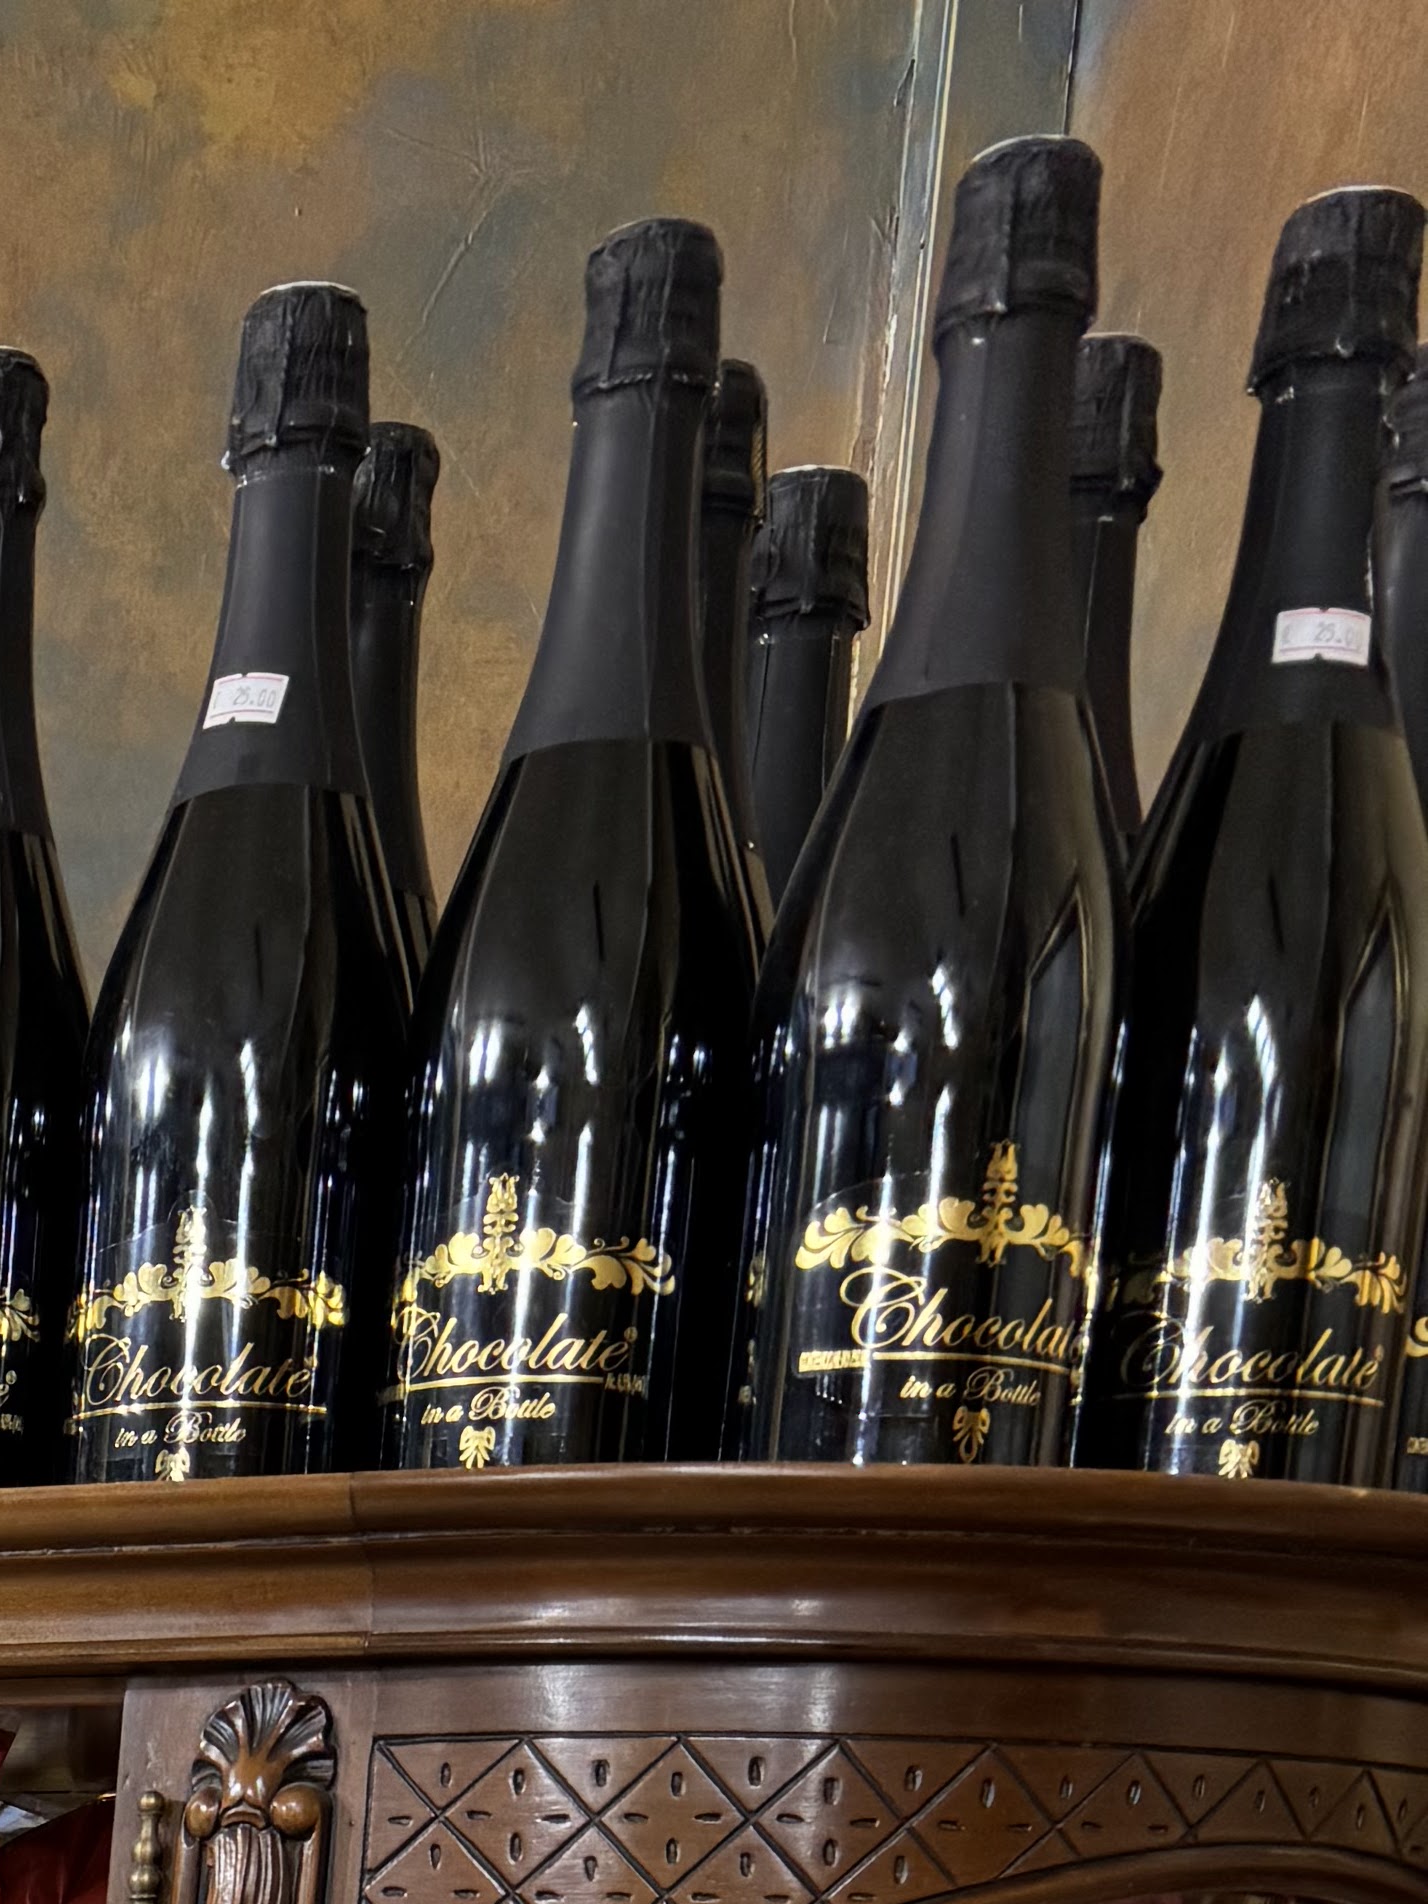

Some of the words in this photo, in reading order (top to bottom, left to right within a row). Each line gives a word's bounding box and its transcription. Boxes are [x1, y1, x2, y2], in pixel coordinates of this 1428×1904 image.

[82, 1334, 311, 1405] Chocolate
[396, 1306, 629, 1380] Chocolate
[1120, 1310, 1378, 1389] Chocolate
[936, 1385, 957, 1399] a
[964, 1367, 1041, 1406] Bottle
[164, 1411, 246, 1444] Bottle
